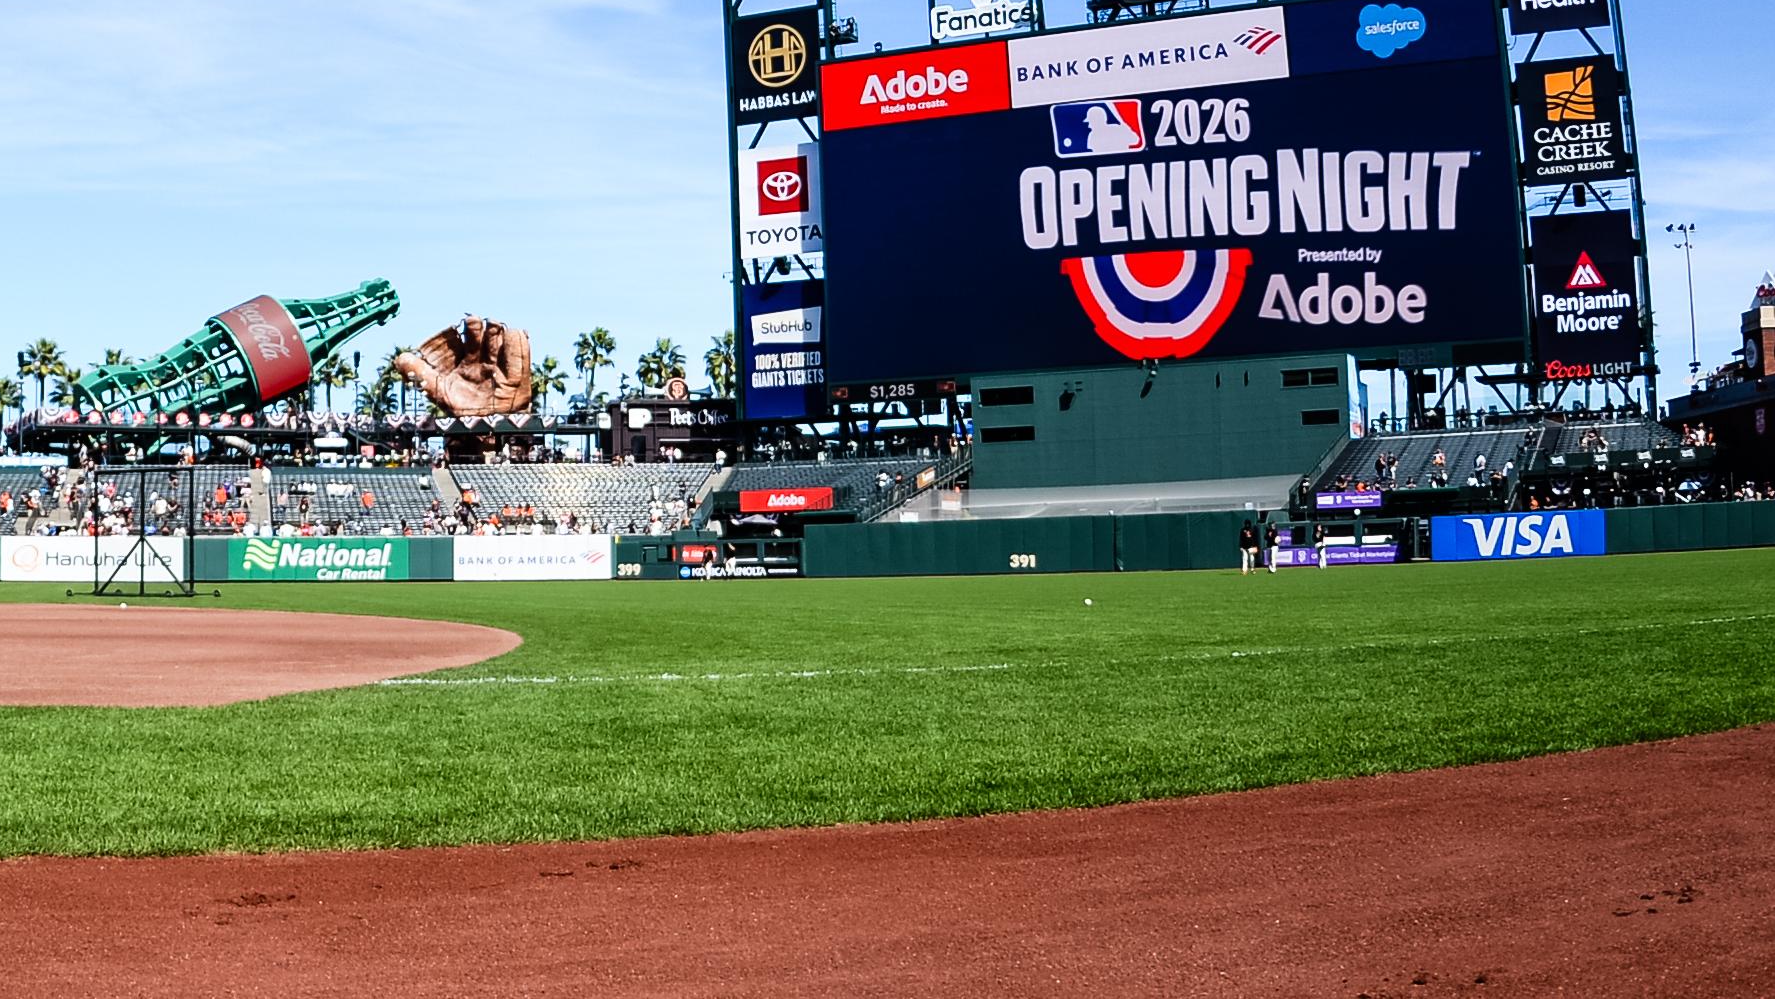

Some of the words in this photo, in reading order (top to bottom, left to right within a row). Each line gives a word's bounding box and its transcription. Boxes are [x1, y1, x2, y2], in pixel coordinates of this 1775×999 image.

[936, 3, 1033, 34] Fanatics
[1365, 17, 1420, 36] salesforce
[1017, 61, 1079, 83] BANK
[1086, 56, 1114, 73] OF
[1121, 42, 1229, 70] AMERICA
[859, 66, 969, 105] Adobe
[740, 95, 790, 111] HABBAS
[792, 91, 817, 106] LAW
[880, 103, 911, 114] Made
[915, 102, 924, 112] to
[1151, 97, 1251, 147] 2026
[1533, 122, 1612, 144] CACHE
[1537, 140, 1612, 162] CREEK
[1537, 164, 1575, 176] CASINO
[1577, 160, 1615, 172] RESORT
[1019, 153, 1270, 250] OPENING
[1276, 147, 1470, 234] NIGHT
[746, 223, 823, 246] TOYOTA
[1298, 247, 1363, 263] Presented
[1366, 248, 1382, 264] by
[1258, 272, 1427, 325] Adobe
[1542, 288, 1631, 315] Benjamin
[760, 319, 813, 335] StubHub
[1557, 314, 1620, 333] Moore
[754, 352, 780, 370] 100%
[781, 350, 821, 369] VERIFIED
[1545, 359, 1592, 379] Coors
[1593, 361, 1633, 376] LIGHT
[751, 370, 785, 388] GIANTS
[786, 368, 824, 386] TICKETS
[869, 383, 916, 400] $1,285
[767, 493, 805, 507] Adobe
[1462, 514, 1574, 557] VISA
[45, 551, 128, 567] Hanwha
[279, 542, 391, 567] National
[458, 556, 496, 565] BANK
[498, 556, 515, 565] OF
[517, 555, 577, 565] AMERICA
[1009, 554, 1036, 568] 391
[316, 568, 339, 580] Car
[341, 567, 386, 580] Rental
[617, 563, 642, 576] 399
